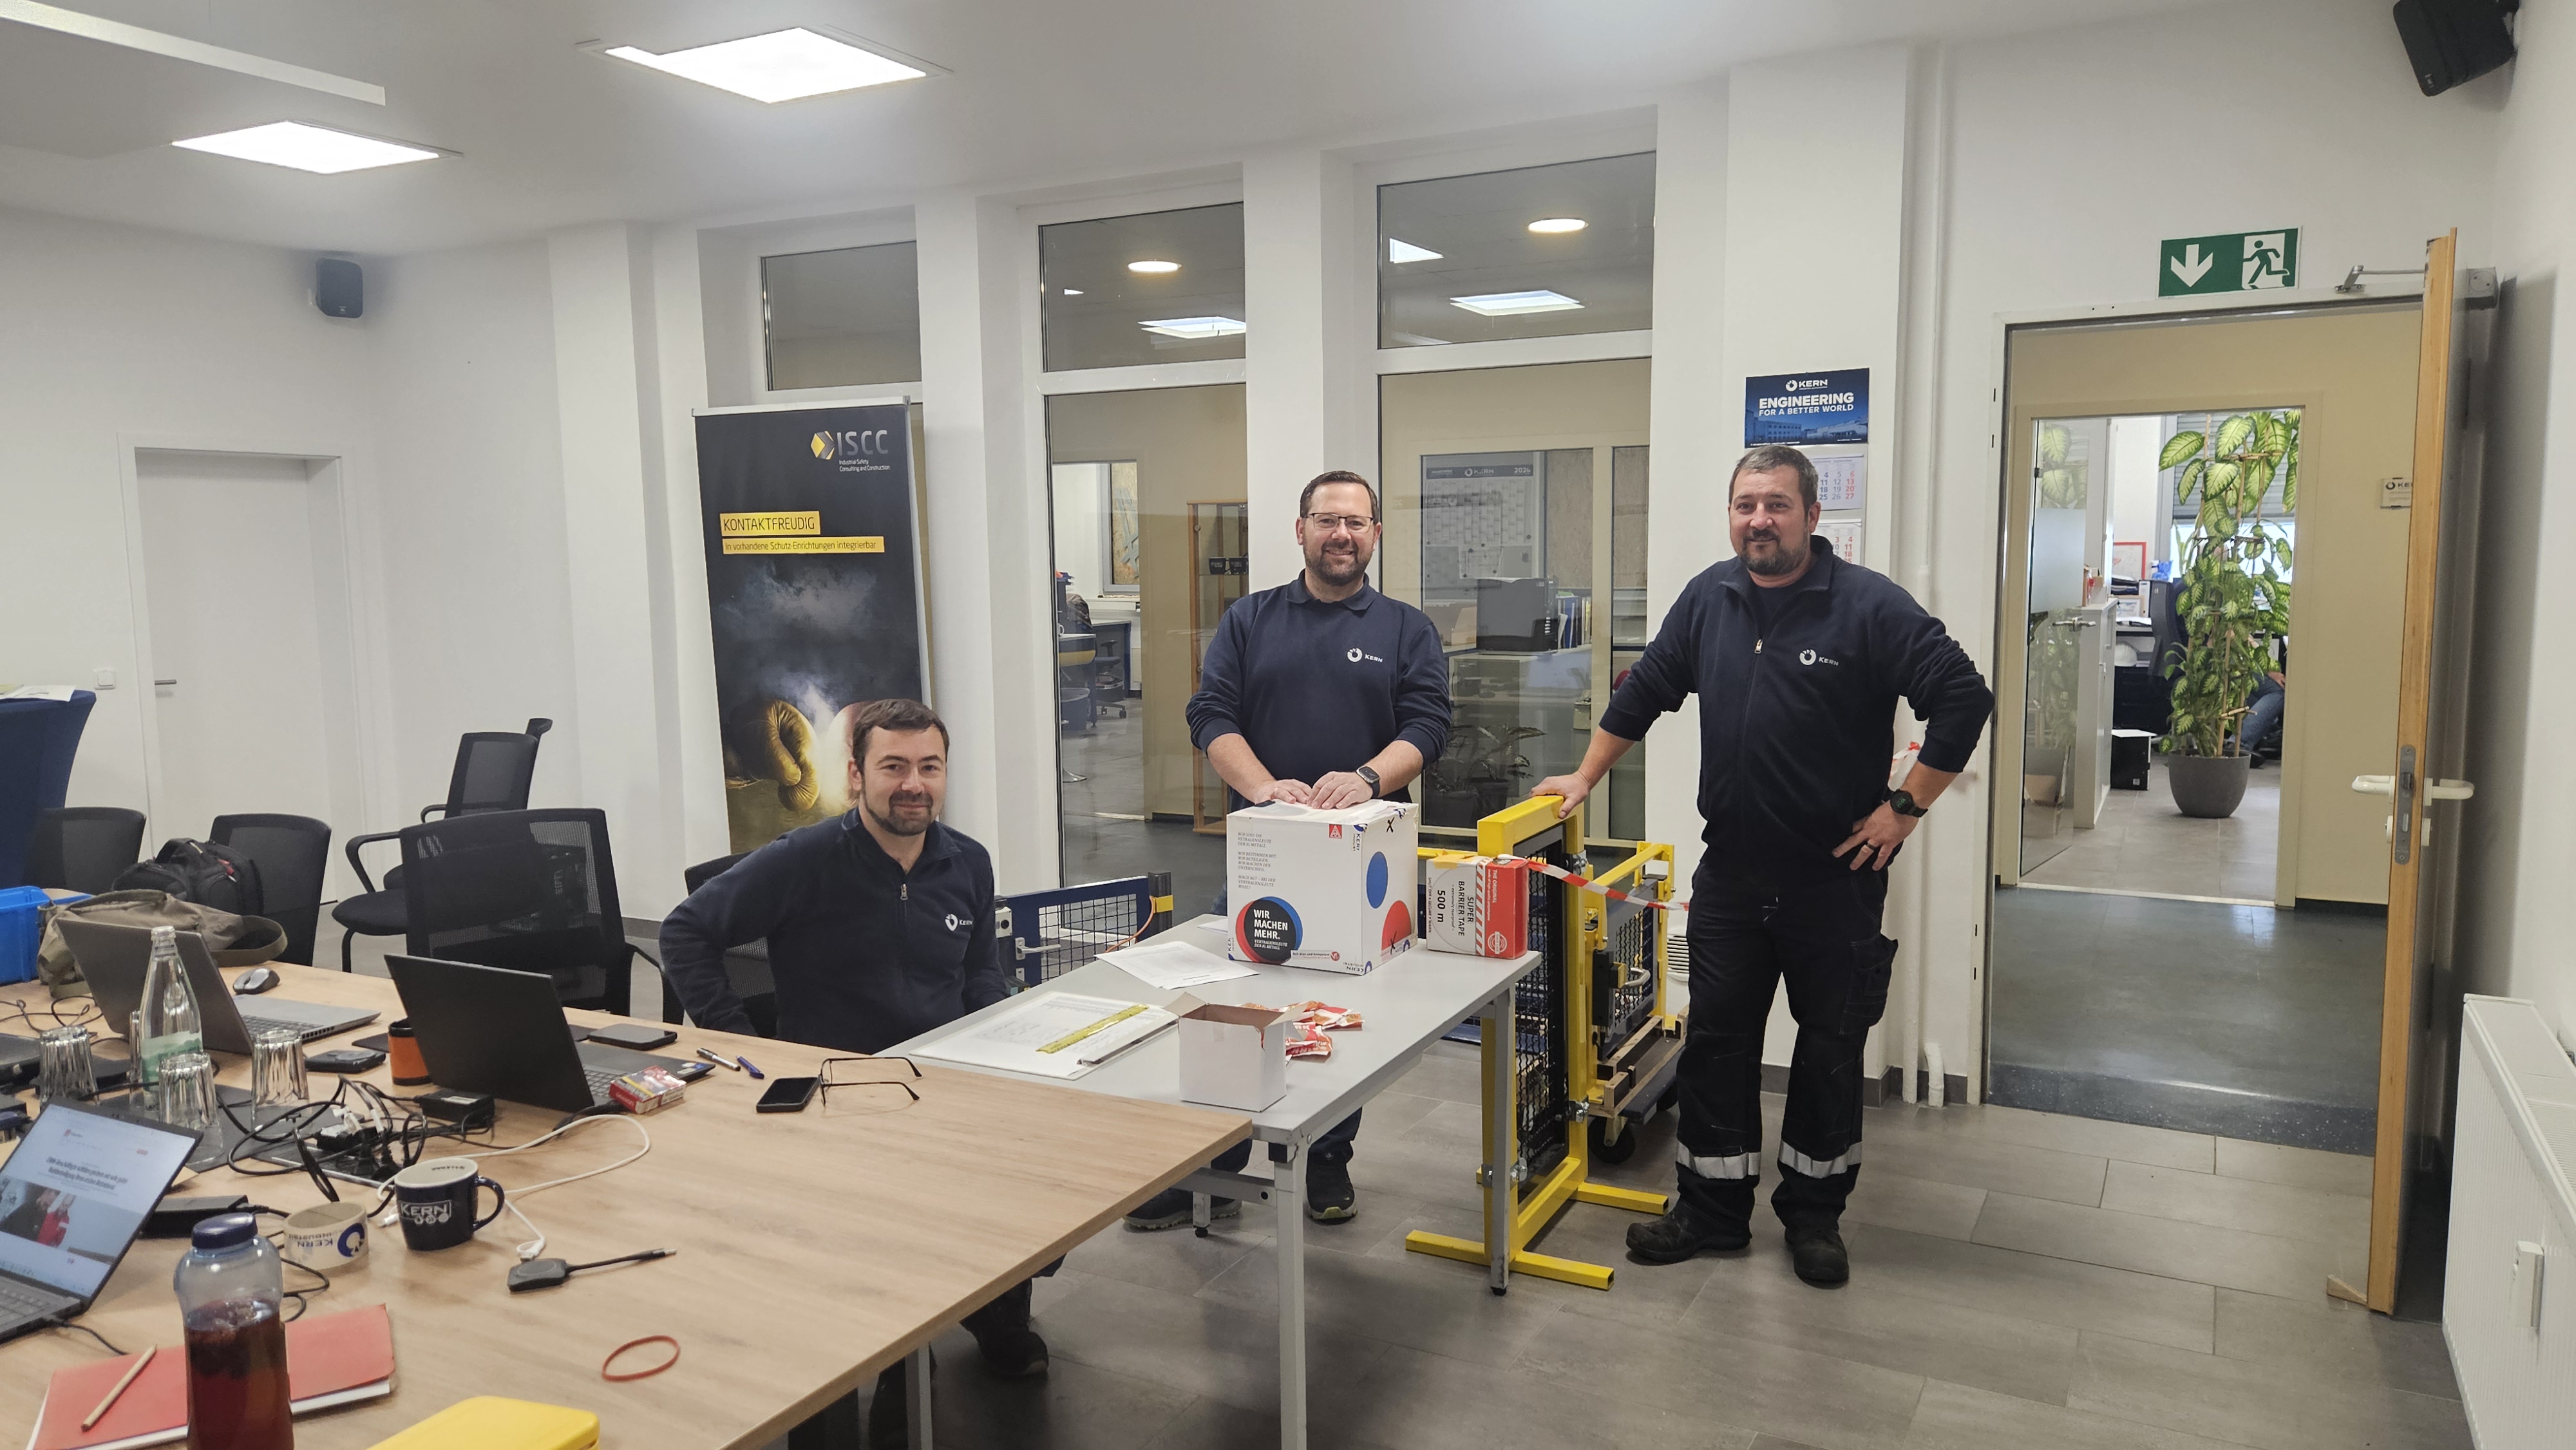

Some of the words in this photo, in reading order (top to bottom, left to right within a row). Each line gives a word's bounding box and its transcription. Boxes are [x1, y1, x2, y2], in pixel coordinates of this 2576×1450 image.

[1799, 379, 1828, 388] KERN
[1759, 392, 1854, 409] ENGINEERING
[1788, 406, 1819, 415] BETTER
[1823, 404, 1854, 412] WORLD
[837, 430, 889, 456] ISCC
[724, 517, 815, 531] KONTAKTFREUDIG
[733, 542, 769, 551] vorhandene
[770, 541, 835, 551] Schutz-Einrichtungen
[837, 541, 876, 551] integrierbar
[1365, 654, 1383, 663] KERN
[1819, 657, 1839, 666] KERN
[1254, 909, 1270, 919] WIR
[1437, 914, 1444, 922] m
[1254, 919, 1288, 931] MACHEN
[1254, 929, 1281, 940] MEHR.
[401, 1203, 447, 1216] KERN
[298, 1238, 333, 1247] KERN
